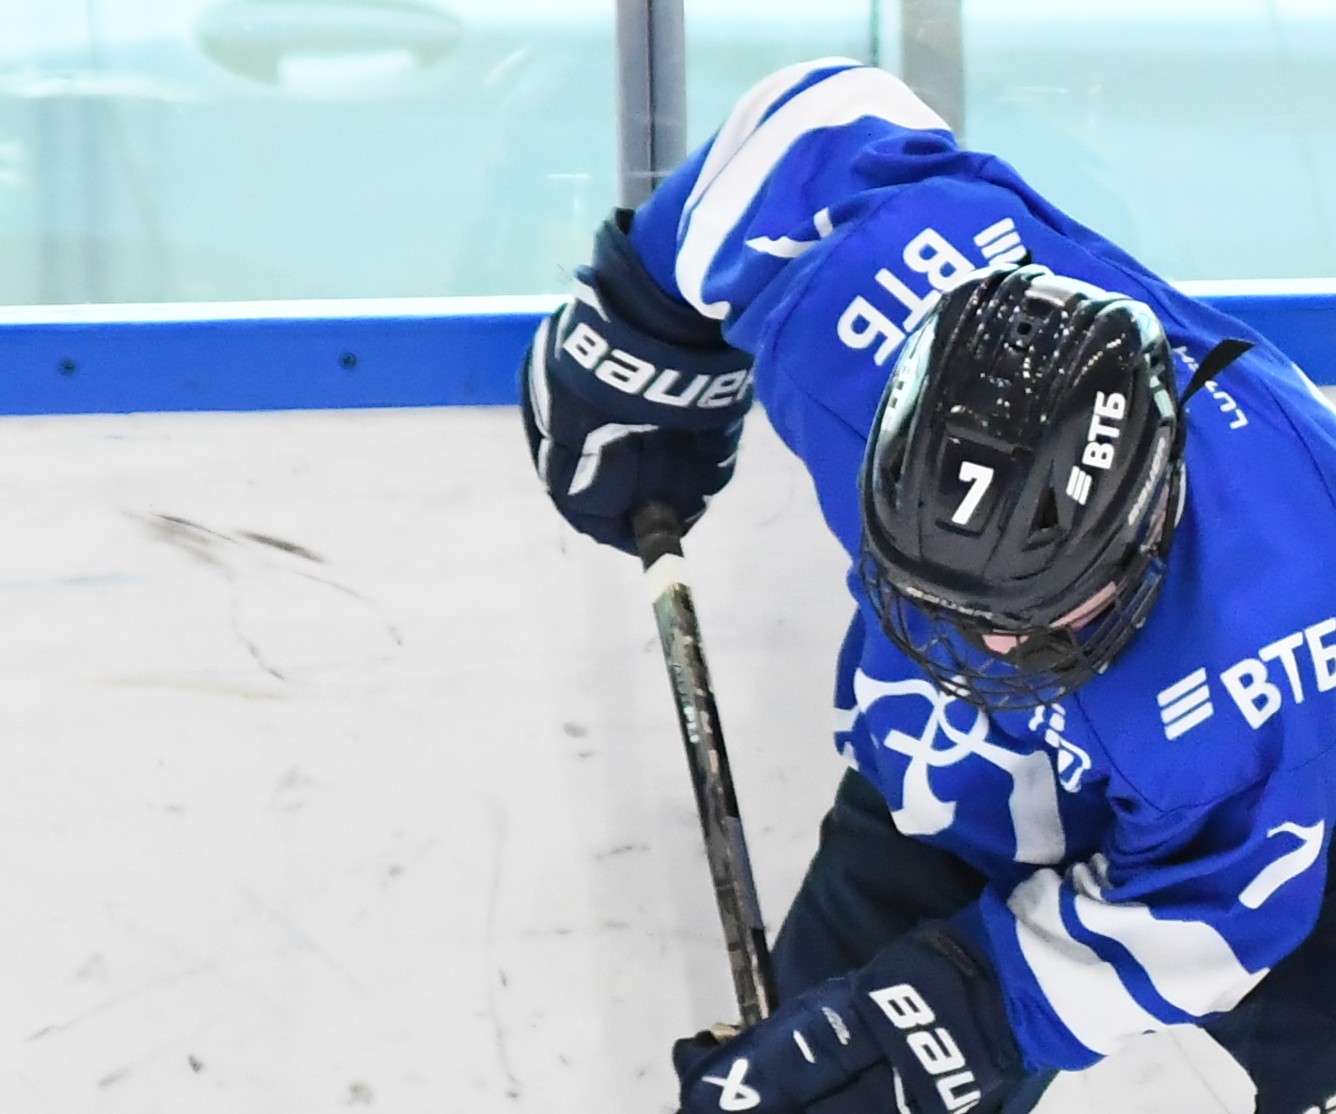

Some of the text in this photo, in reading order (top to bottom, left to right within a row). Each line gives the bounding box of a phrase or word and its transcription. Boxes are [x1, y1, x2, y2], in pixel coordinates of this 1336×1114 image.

[837, 228, 976, 367] ВТБ
[1082, 391, 1126, 470] ВТБ
[951, 460, 995, 526] 7
[1238, 818, 1325, 910] 7
